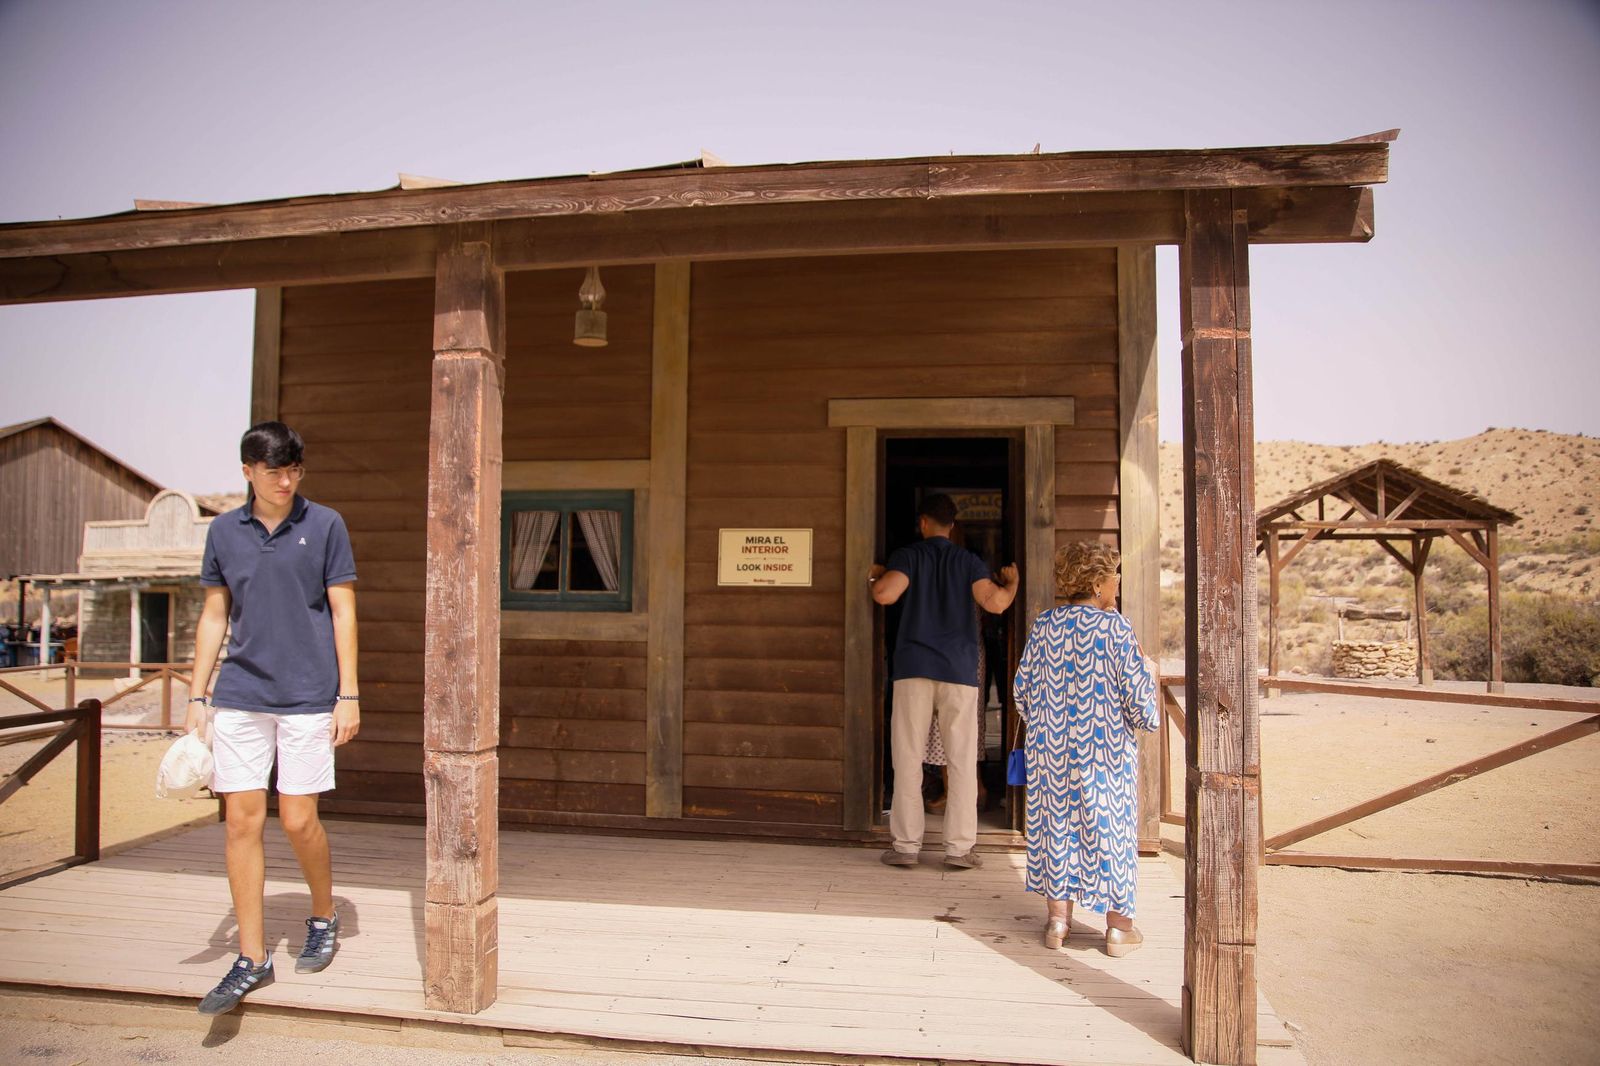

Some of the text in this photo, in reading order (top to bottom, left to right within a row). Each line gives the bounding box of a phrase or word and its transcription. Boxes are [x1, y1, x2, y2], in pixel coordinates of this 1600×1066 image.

[745, 536, 786, 544] MIRA EL
[741, 545, 789, 554] INTERIOR
